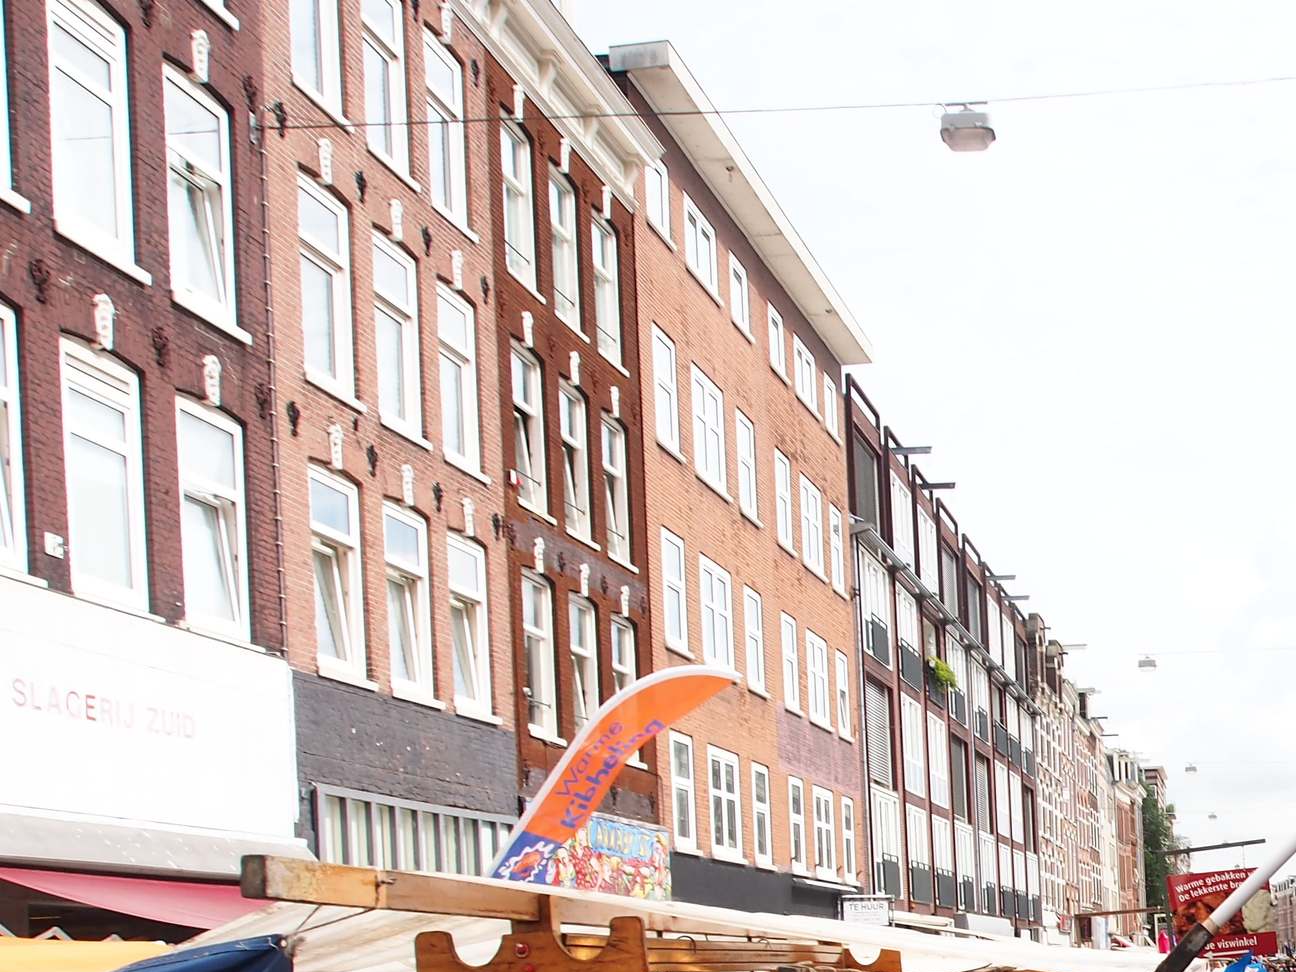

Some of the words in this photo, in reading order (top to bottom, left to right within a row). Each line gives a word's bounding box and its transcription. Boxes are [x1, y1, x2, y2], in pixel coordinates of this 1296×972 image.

[146, 706, 195, 739] ZUID
[1175, 877, 1205, 893] Warme
[1205, 870, 1247, 887] gebakken
[1178, 893, 1190, 903] De
[1190, 883, 1229, 898] lekkerste
[848, 902, 860, 911] TE
[1216, 935, 1258, 949] viswinkel
